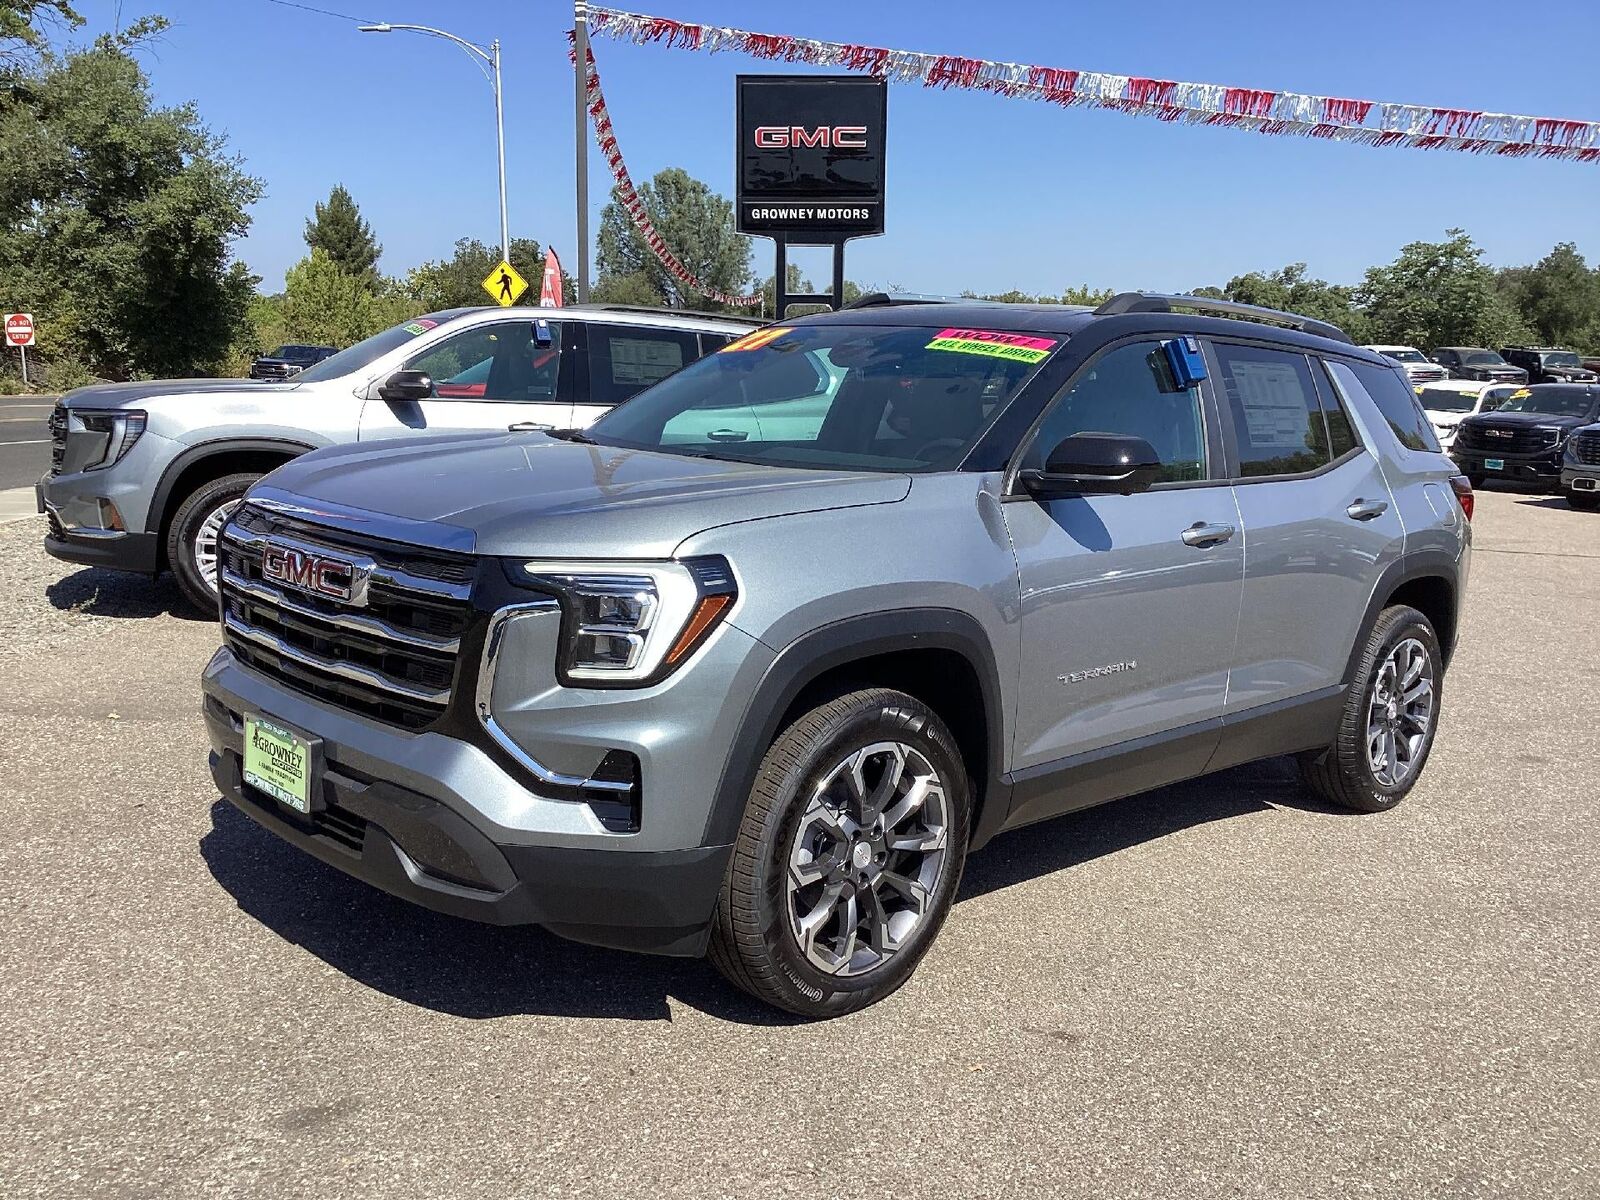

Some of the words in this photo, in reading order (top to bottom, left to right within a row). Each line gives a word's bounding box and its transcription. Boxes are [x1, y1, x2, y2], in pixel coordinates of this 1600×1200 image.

[754, 126, 867, 148] GMC
[752, 209, 814, 219] GROWNEY
[817, 209, 869, 219] MOTORS
[935, 340, 958, 349] ALL
[959, 342, 999, 353] WHEEL
[1001, 347, 1042, 359] DRIVE
[262, 540, 353, 601] GMC
[1057, 660, 1138, 684] TERRAIN
[259, 737, 303, 769] GROWNEY
